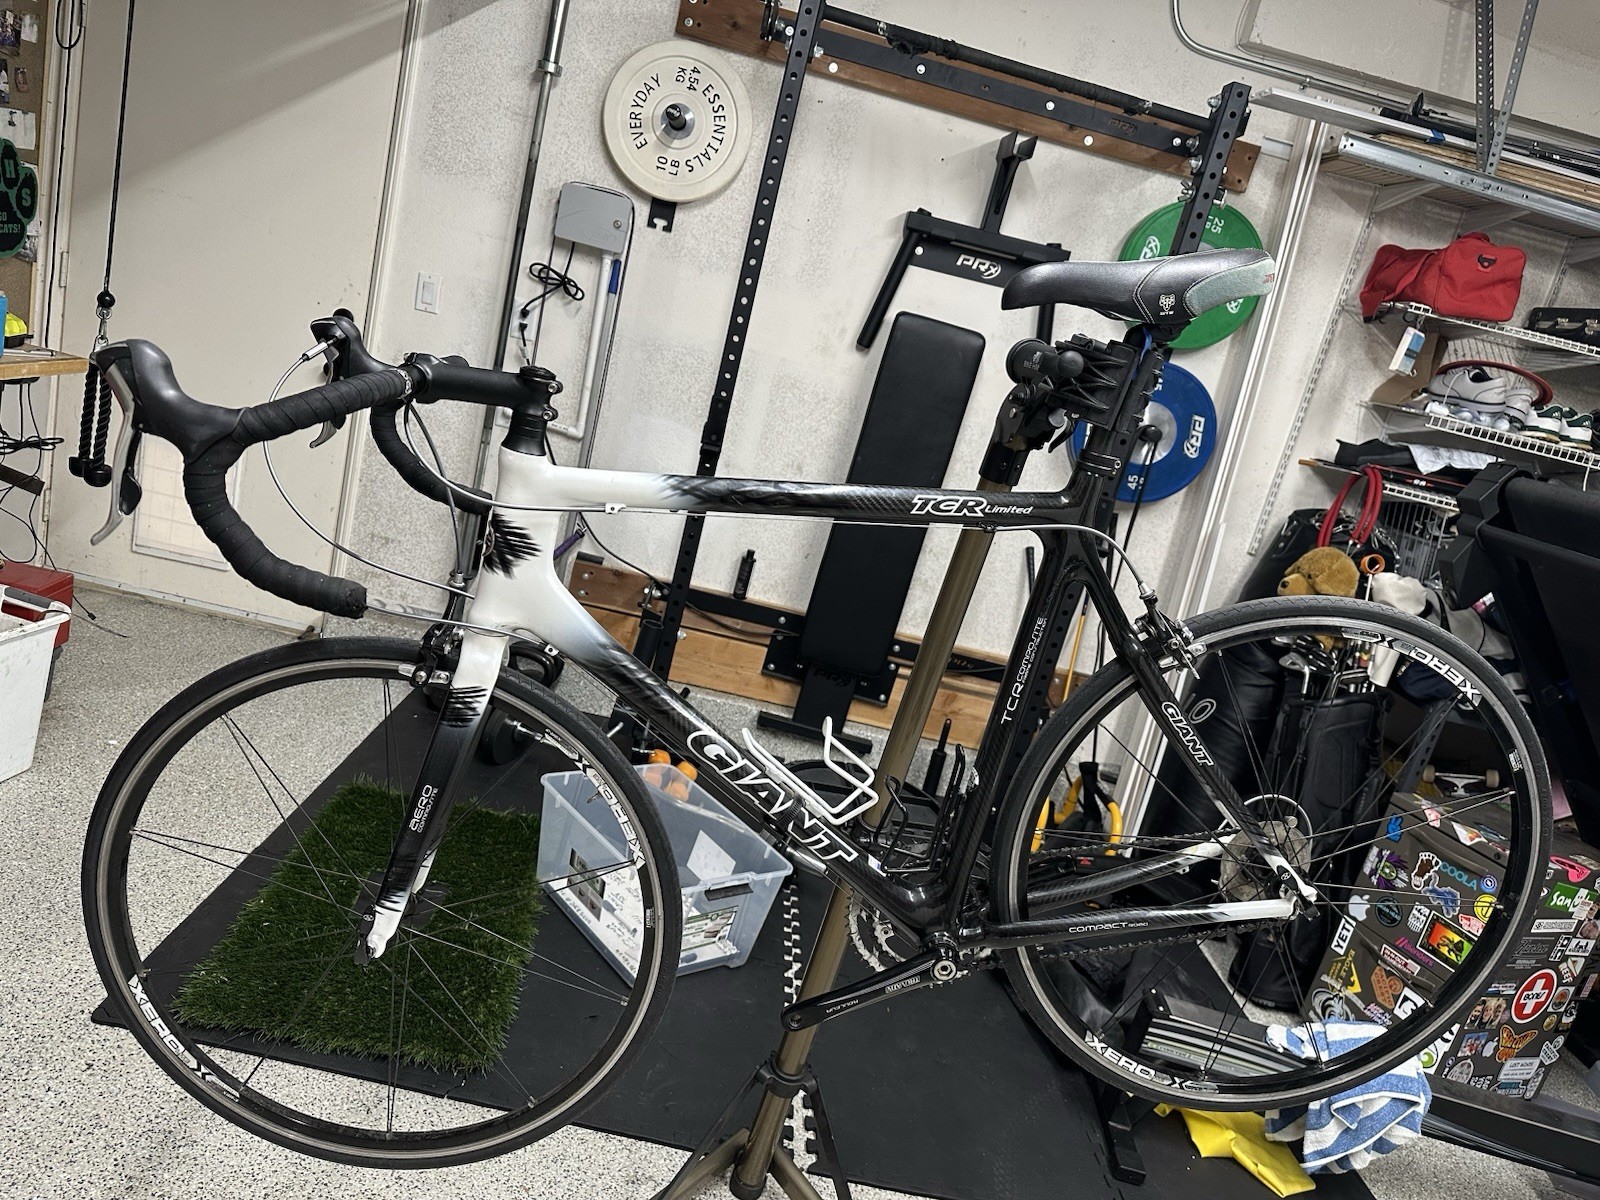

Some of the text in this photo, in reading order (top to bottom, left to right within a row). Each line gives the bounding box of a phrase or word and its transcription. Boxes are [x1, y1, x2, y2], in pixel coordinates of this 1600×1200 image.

[675, 66, 688, 84] KG
[686, 66, 701, 92] 4.54
[629, 73, 727, 173] EVERYDAY ESSENTIALS
[4, 159, 16, 179] H
[655, 155, 668, 172] 10
[668, 159, 680, 176] LB
[21, 188, 32, 207] S
[1211, 217, 1225, 234] 25
[1127, 474, 1139, 490] 45
[910, 494, 1034, 517] TCR Limited
[1409, 646, 1482, 701] XERO
[1000, 682, 1024, 725] TCR
[1161, 701, 1215, 767] GIANT
[408, 784, 433, 832] AERO
[686, 730, 860, 863] GIANT
[599, 785, 647, 864] XERO
[1440, 861, 1478, 891] COOLA
[1068, 921, 1128, 934] COMPACT
[128, 979, 186, 1054] XERO
[1085, 1032, 1156, 1079] XERO
